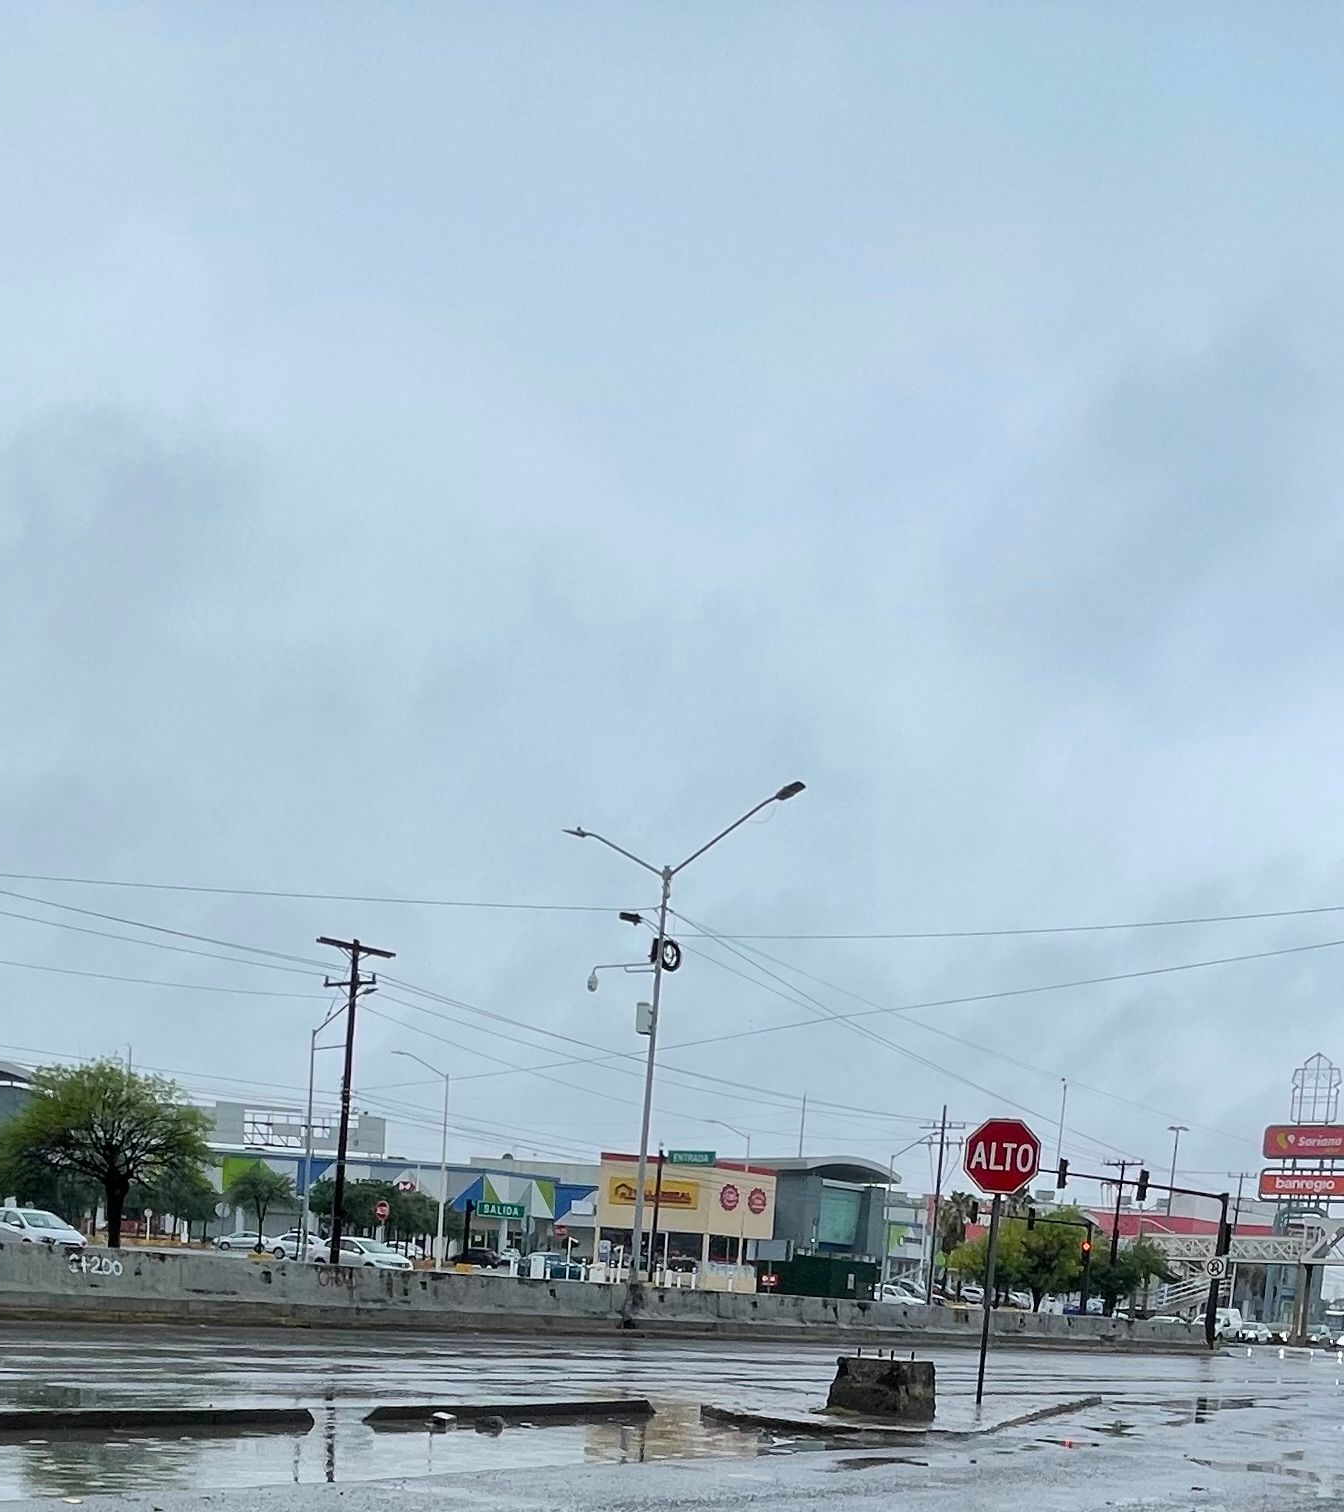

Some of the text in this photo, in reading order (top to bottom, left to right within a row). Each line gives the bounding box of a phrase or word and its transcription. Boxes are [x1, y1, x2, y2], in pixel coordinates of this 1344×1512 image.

[1297, 1134, 1343, 1147] Soriana
[969, 1141, 1034, 1172] ALTO
[1275, 1177, 1336, 1193] banregio
[483, 1204, 519, 1216] SALIDA
